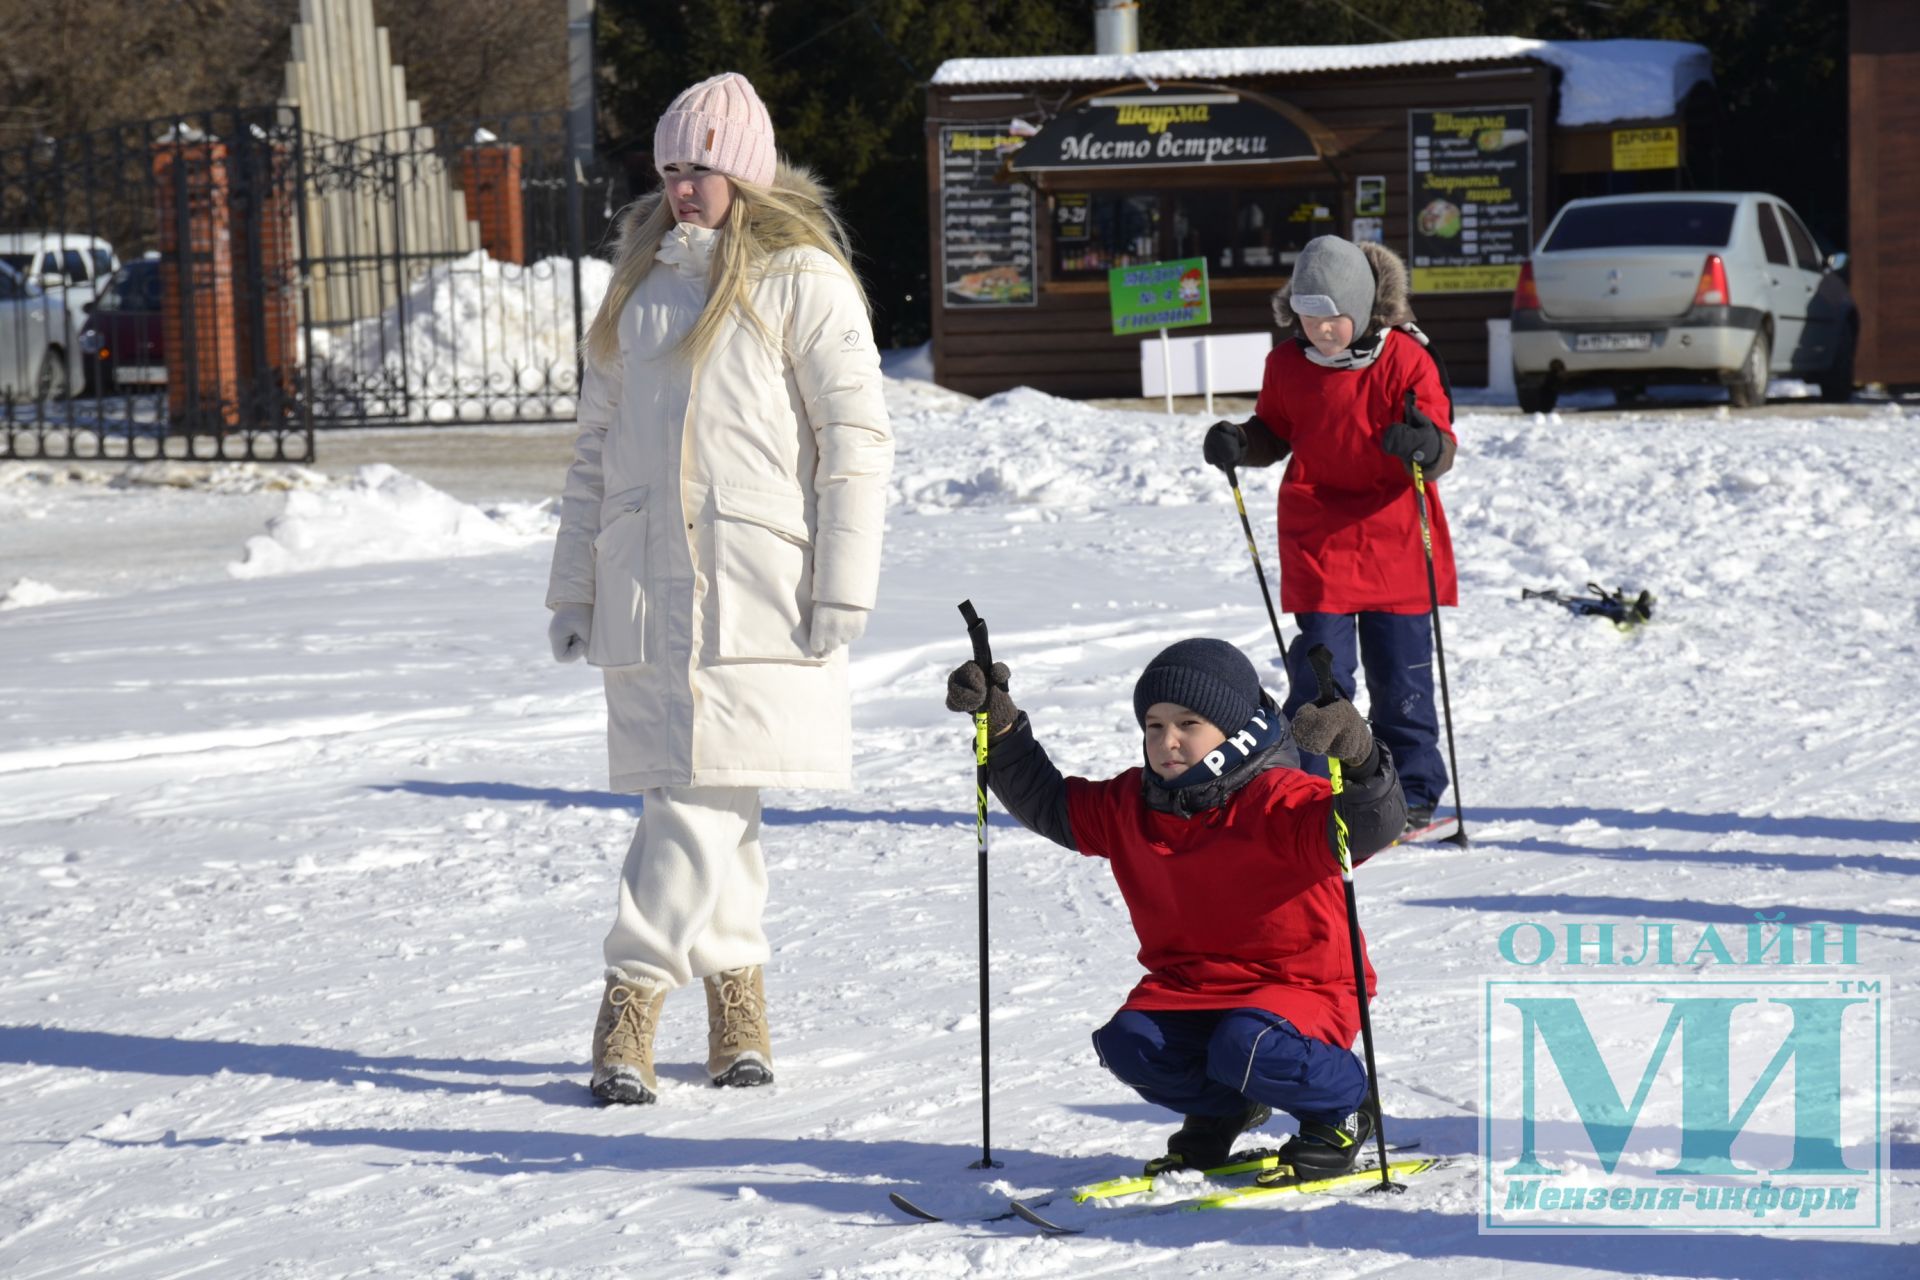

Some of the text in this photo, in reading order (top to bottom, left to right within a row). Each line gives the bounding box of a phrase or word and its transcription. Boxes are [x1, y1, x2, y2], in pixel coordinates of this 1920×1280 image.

[1116, 104, 1211, 134] Шаурма
[1432, 112, 1507, 138] Шаурма
[1060, 132, 1268, 161] Место встречи
[1203, 709, 1268, 776] PHI
